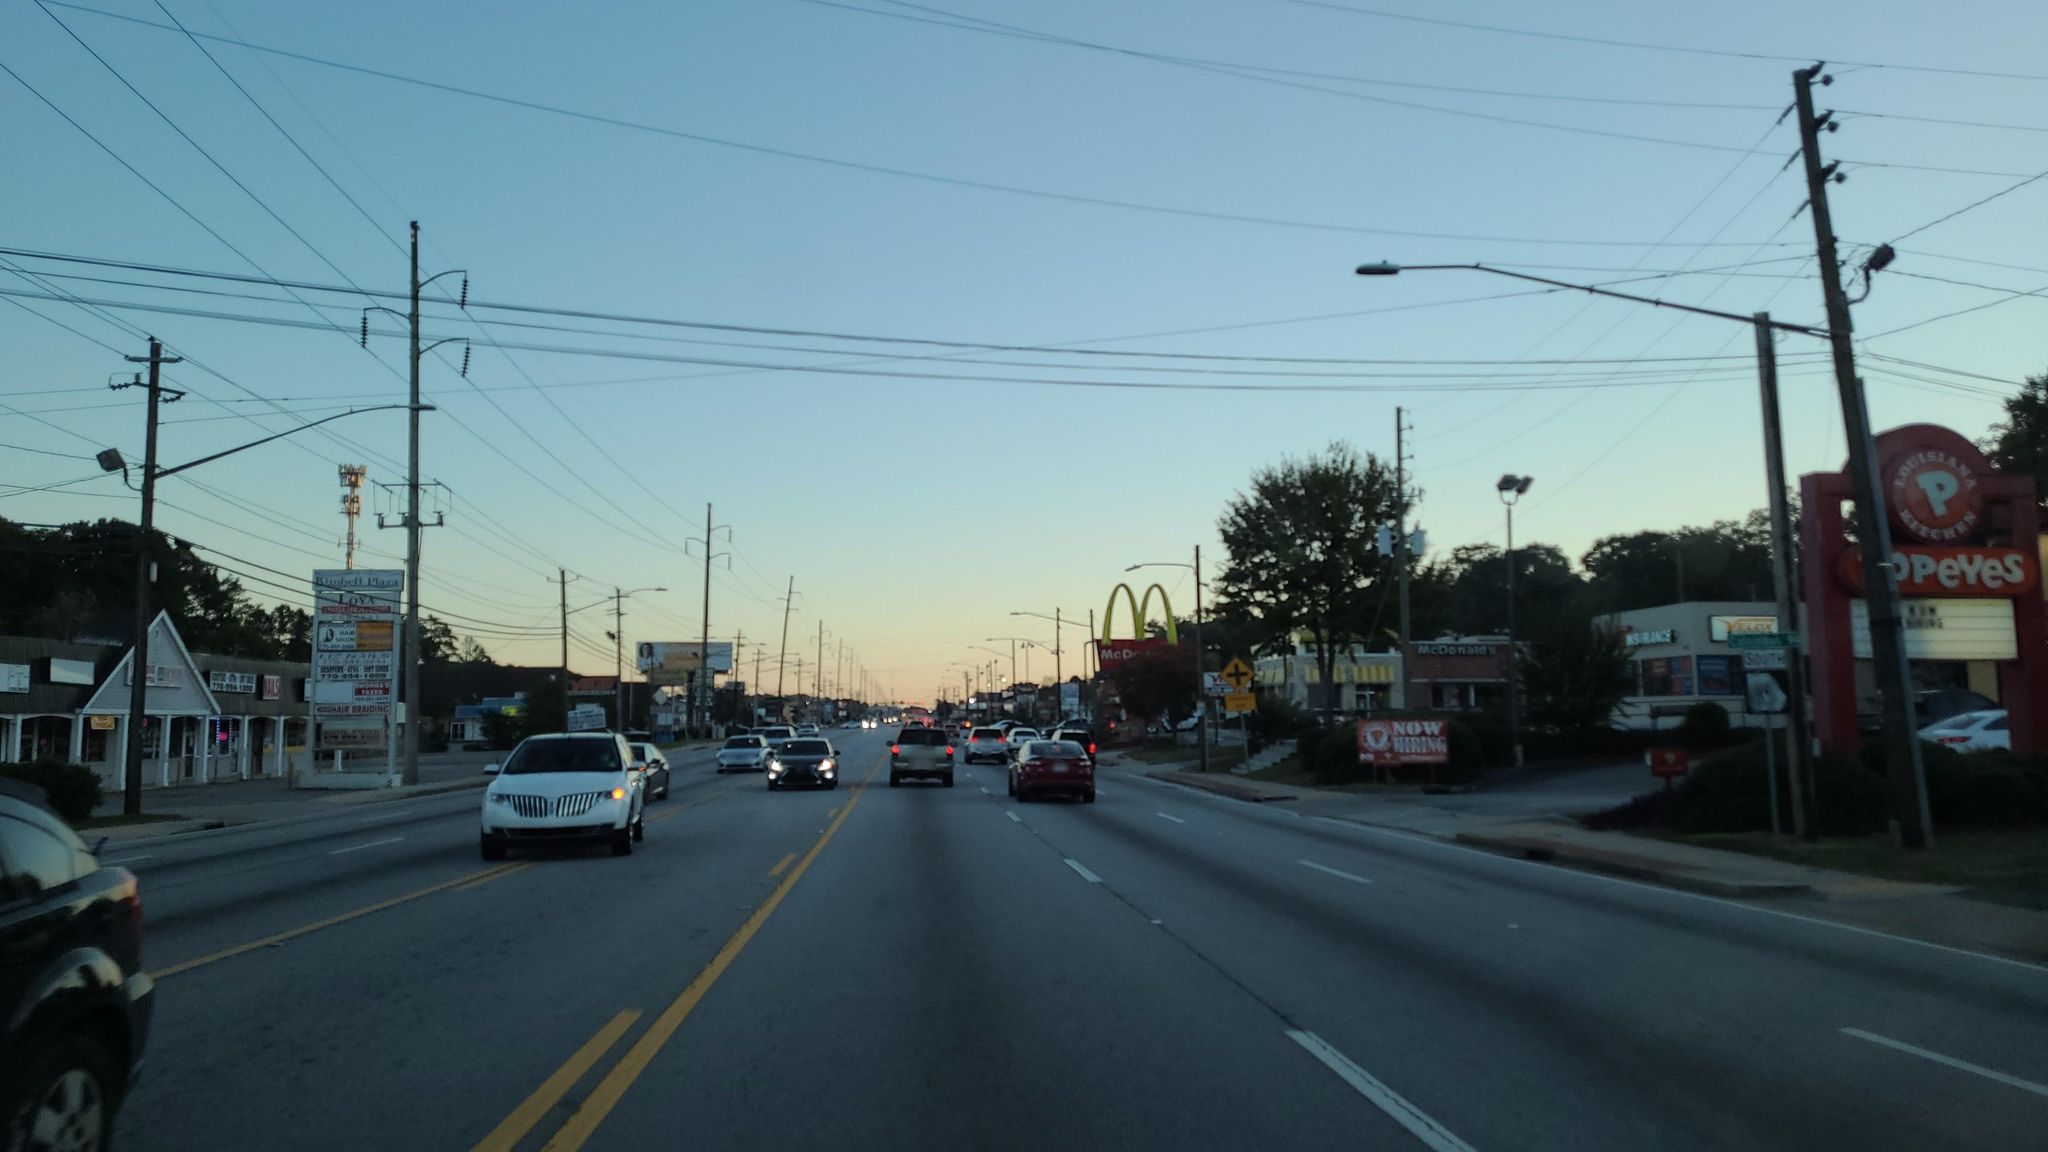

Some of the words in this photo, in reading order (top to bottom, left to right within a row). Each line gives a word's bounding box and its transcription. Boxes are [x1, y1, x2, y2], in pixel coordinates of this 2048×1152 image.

[1895, 451, 1976, 489] LOUISIANA
[1916, 470, 1959, 517] P
[367, 577, 399, 587] Plaza
[331, 706, 350, 714] HAIR
[352, 706, 389, 714] BRAIDING
[1392, 721, 1442, 736] NOW
[1393, 736, 1447, 753] HIRING
